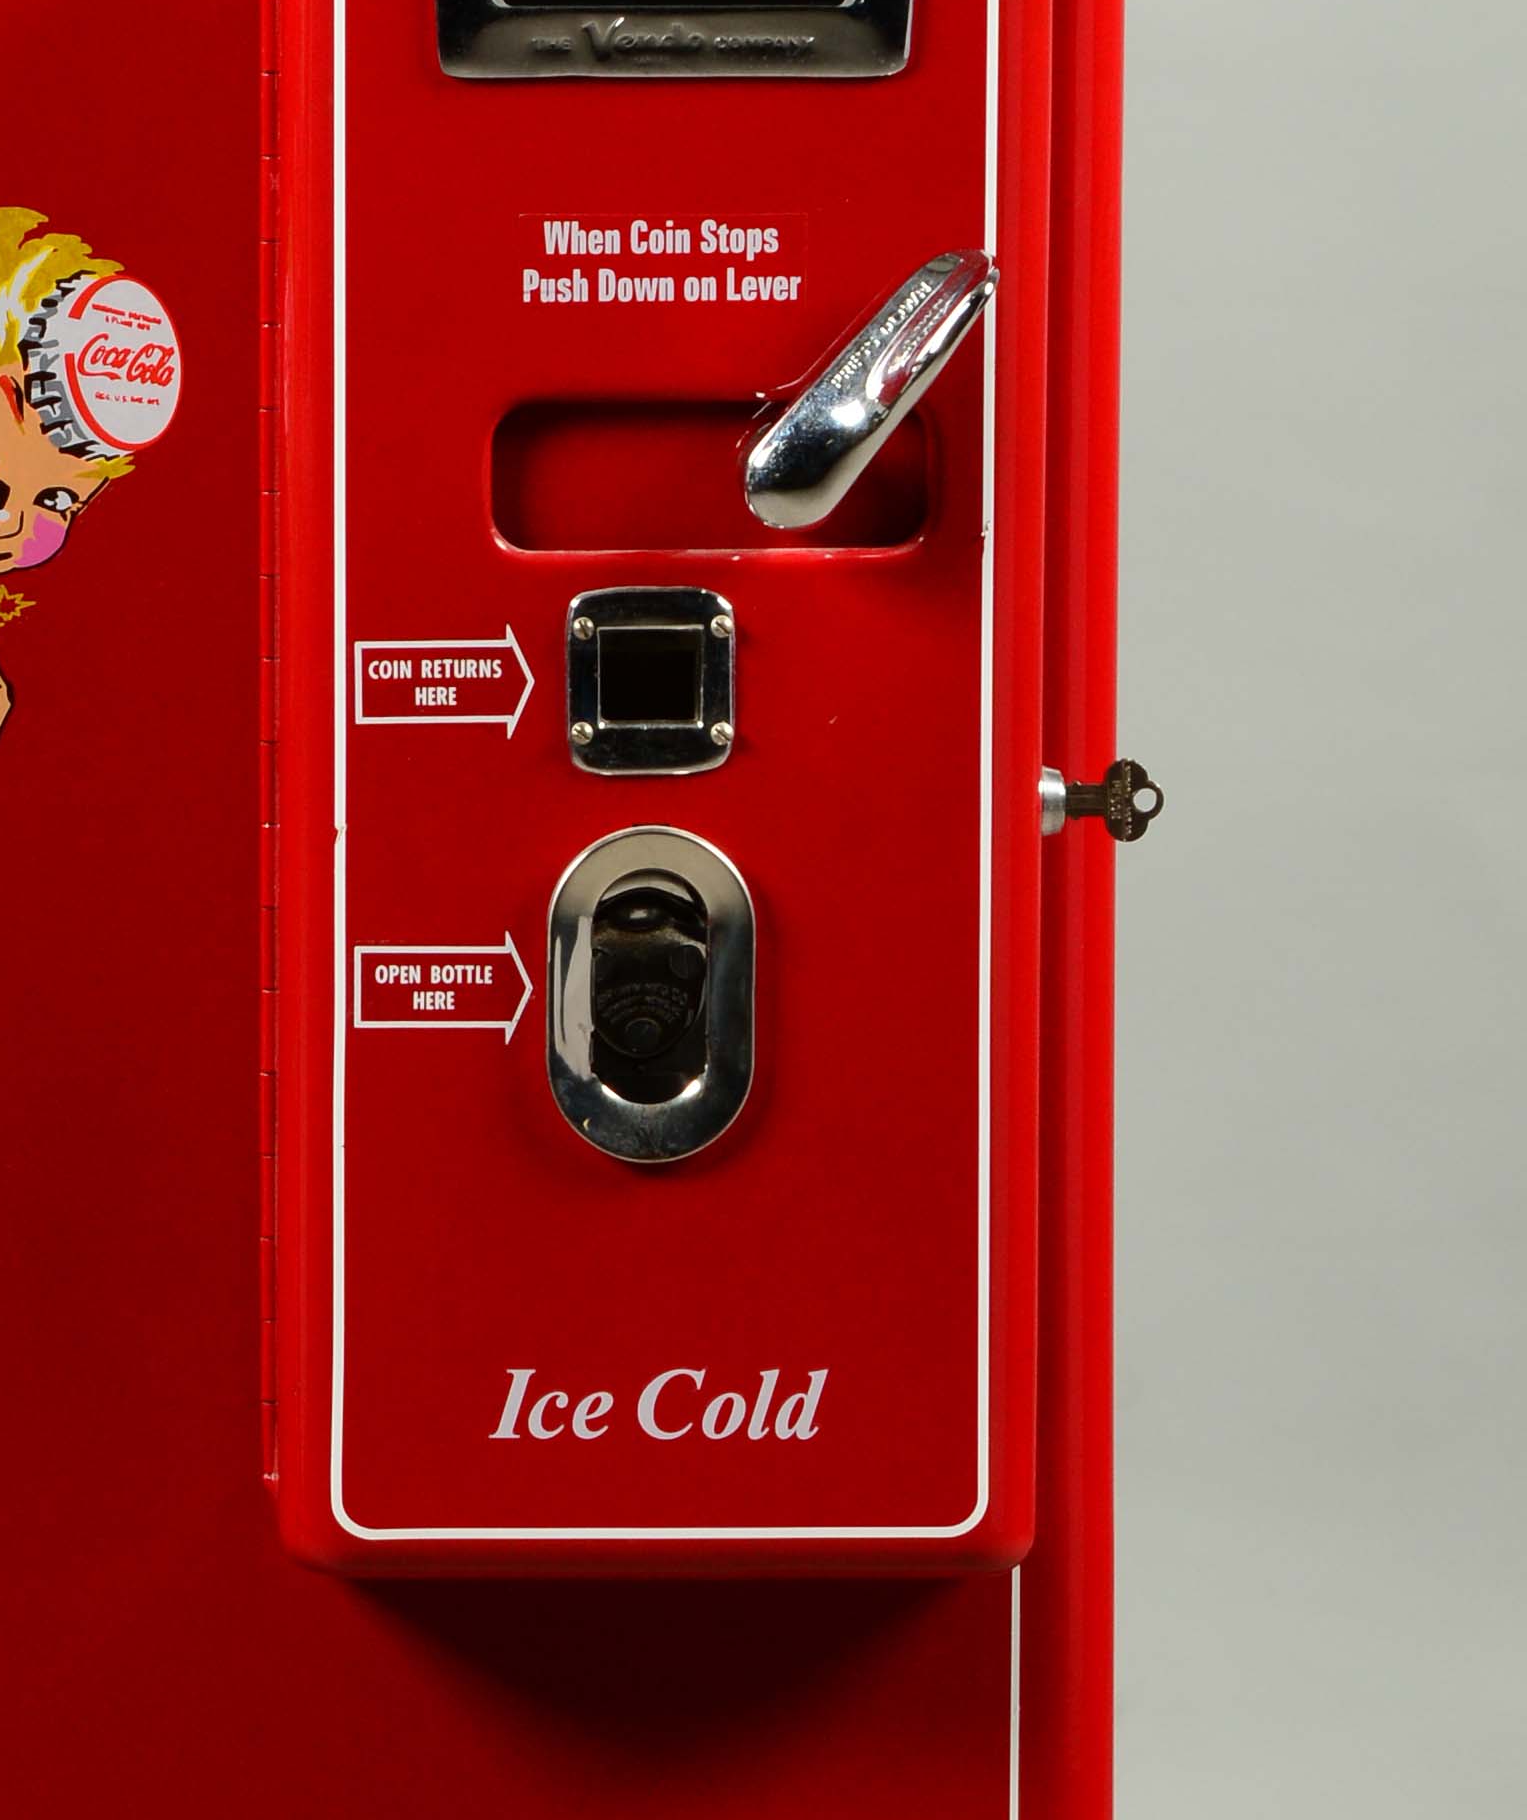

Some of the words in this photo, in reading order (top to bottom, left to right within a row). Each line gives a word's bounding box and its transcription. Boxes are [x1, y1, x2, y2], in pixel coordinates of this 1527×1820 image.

[581, 16, 705, 63] Vendo
[712, 35, 816, 54] COMPANY
[543, 220, 621, 255] When
[629, 219, 691, 255] Coin
[699, 218, 780, 262] Stops
[522, 268, 590, 303] Push
[597, 267, 675, 303] Down
[683, 275, 718, 302] on
[725, 266, 802, 302] Lever
[367, 659, 412, 680] COIN
[420, 658, 504, 679] RETURNS
[414, 686, 458, 707] HERE
[374, 964, 422, 985] OPEN
[430, 964, 493, 985] BOTTLE
[412, 990, 456, 1011] HERE
[487, 1368, 615, 1441] Ice
[636, 1366, 830, 1442] Cold
